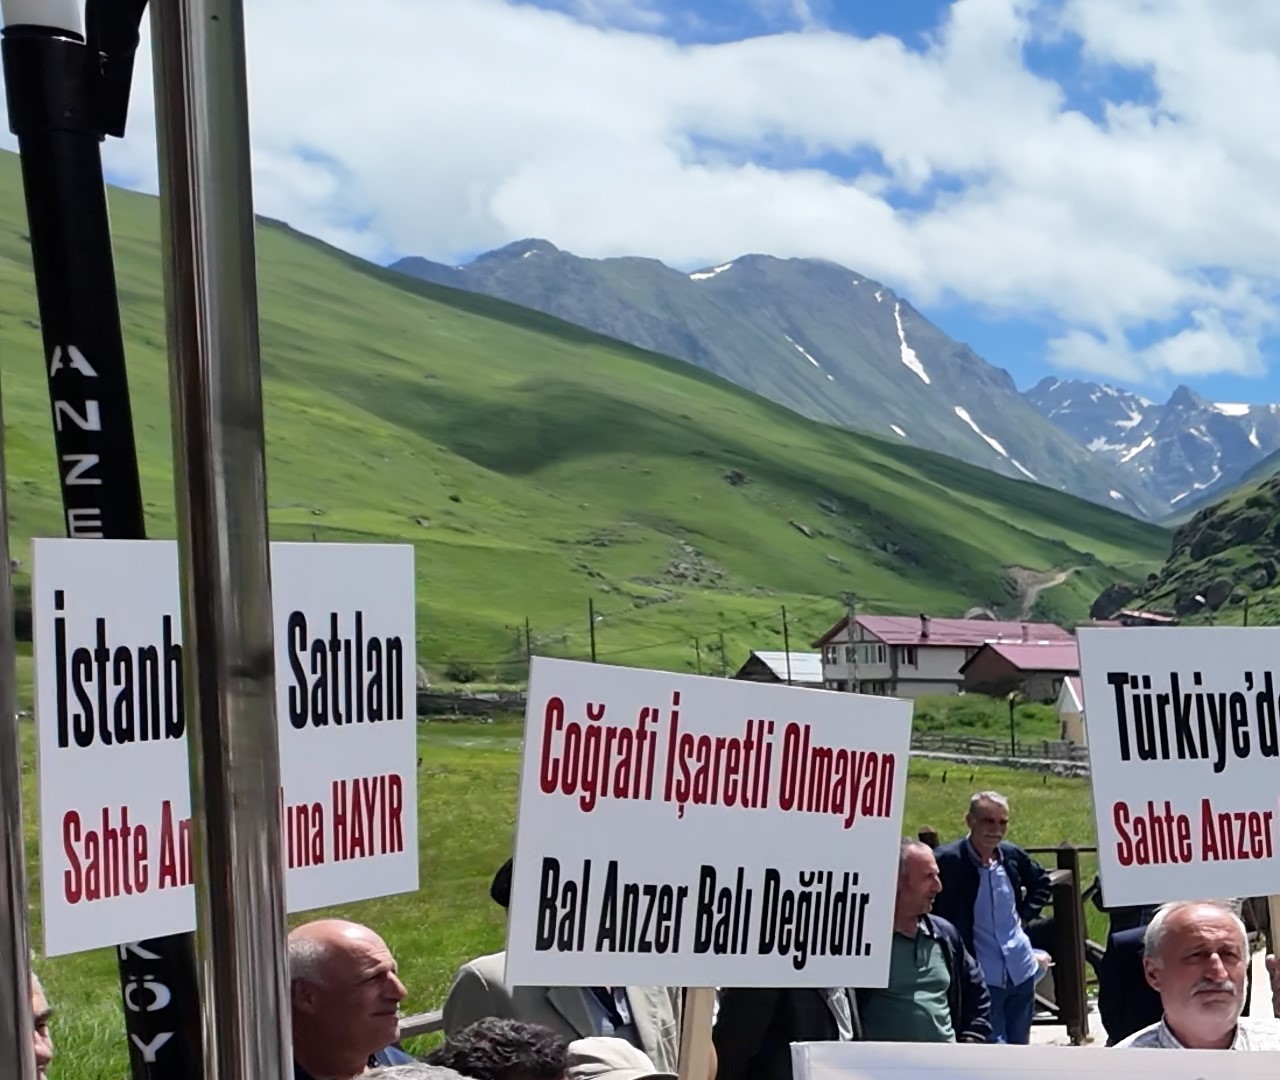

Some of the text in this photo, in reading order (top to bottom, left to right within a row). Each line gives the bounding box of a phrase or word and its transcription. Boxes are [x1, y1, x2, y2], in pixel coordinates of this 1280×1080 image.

[50, 344, 103, 539] ANZE
[54, 590, 403, 748] İstanb Satılan
[539, 691, 895, 830] Coğrafi İşaretli Olmayan
[63, 810, 148, 904] Sahte
[332, 774, 403, 862] HAYIR
[1113, 800, 1193, 867] Sahte
[1201, 798, 1273, 862] Anzer
[534, 856, 872, 971] Bal Anzer Balı Değildir.
